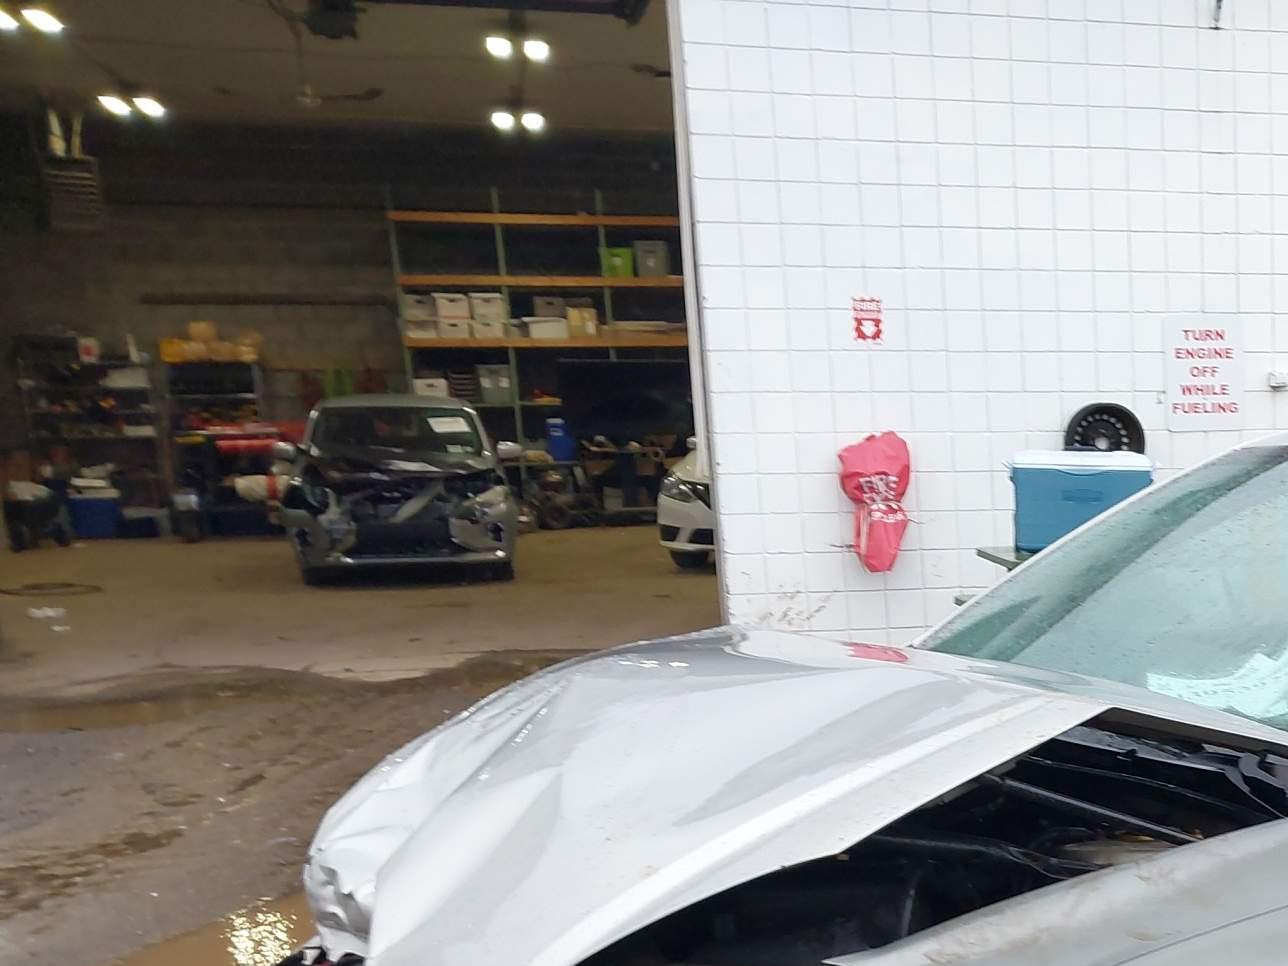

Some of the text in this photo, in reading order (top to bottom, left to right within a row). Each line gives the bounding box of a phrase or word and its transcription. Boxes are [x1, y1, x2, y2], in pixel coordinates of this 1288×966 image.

[1182, 329, 1225, 341] TURN
[1175, 347, 1235, 359] ENGINE
[1190, 366, 1220, 377] OFF
[1180, 384, 1230, 395] WHILE
[1171, 402, 1240, 414] FUELING
